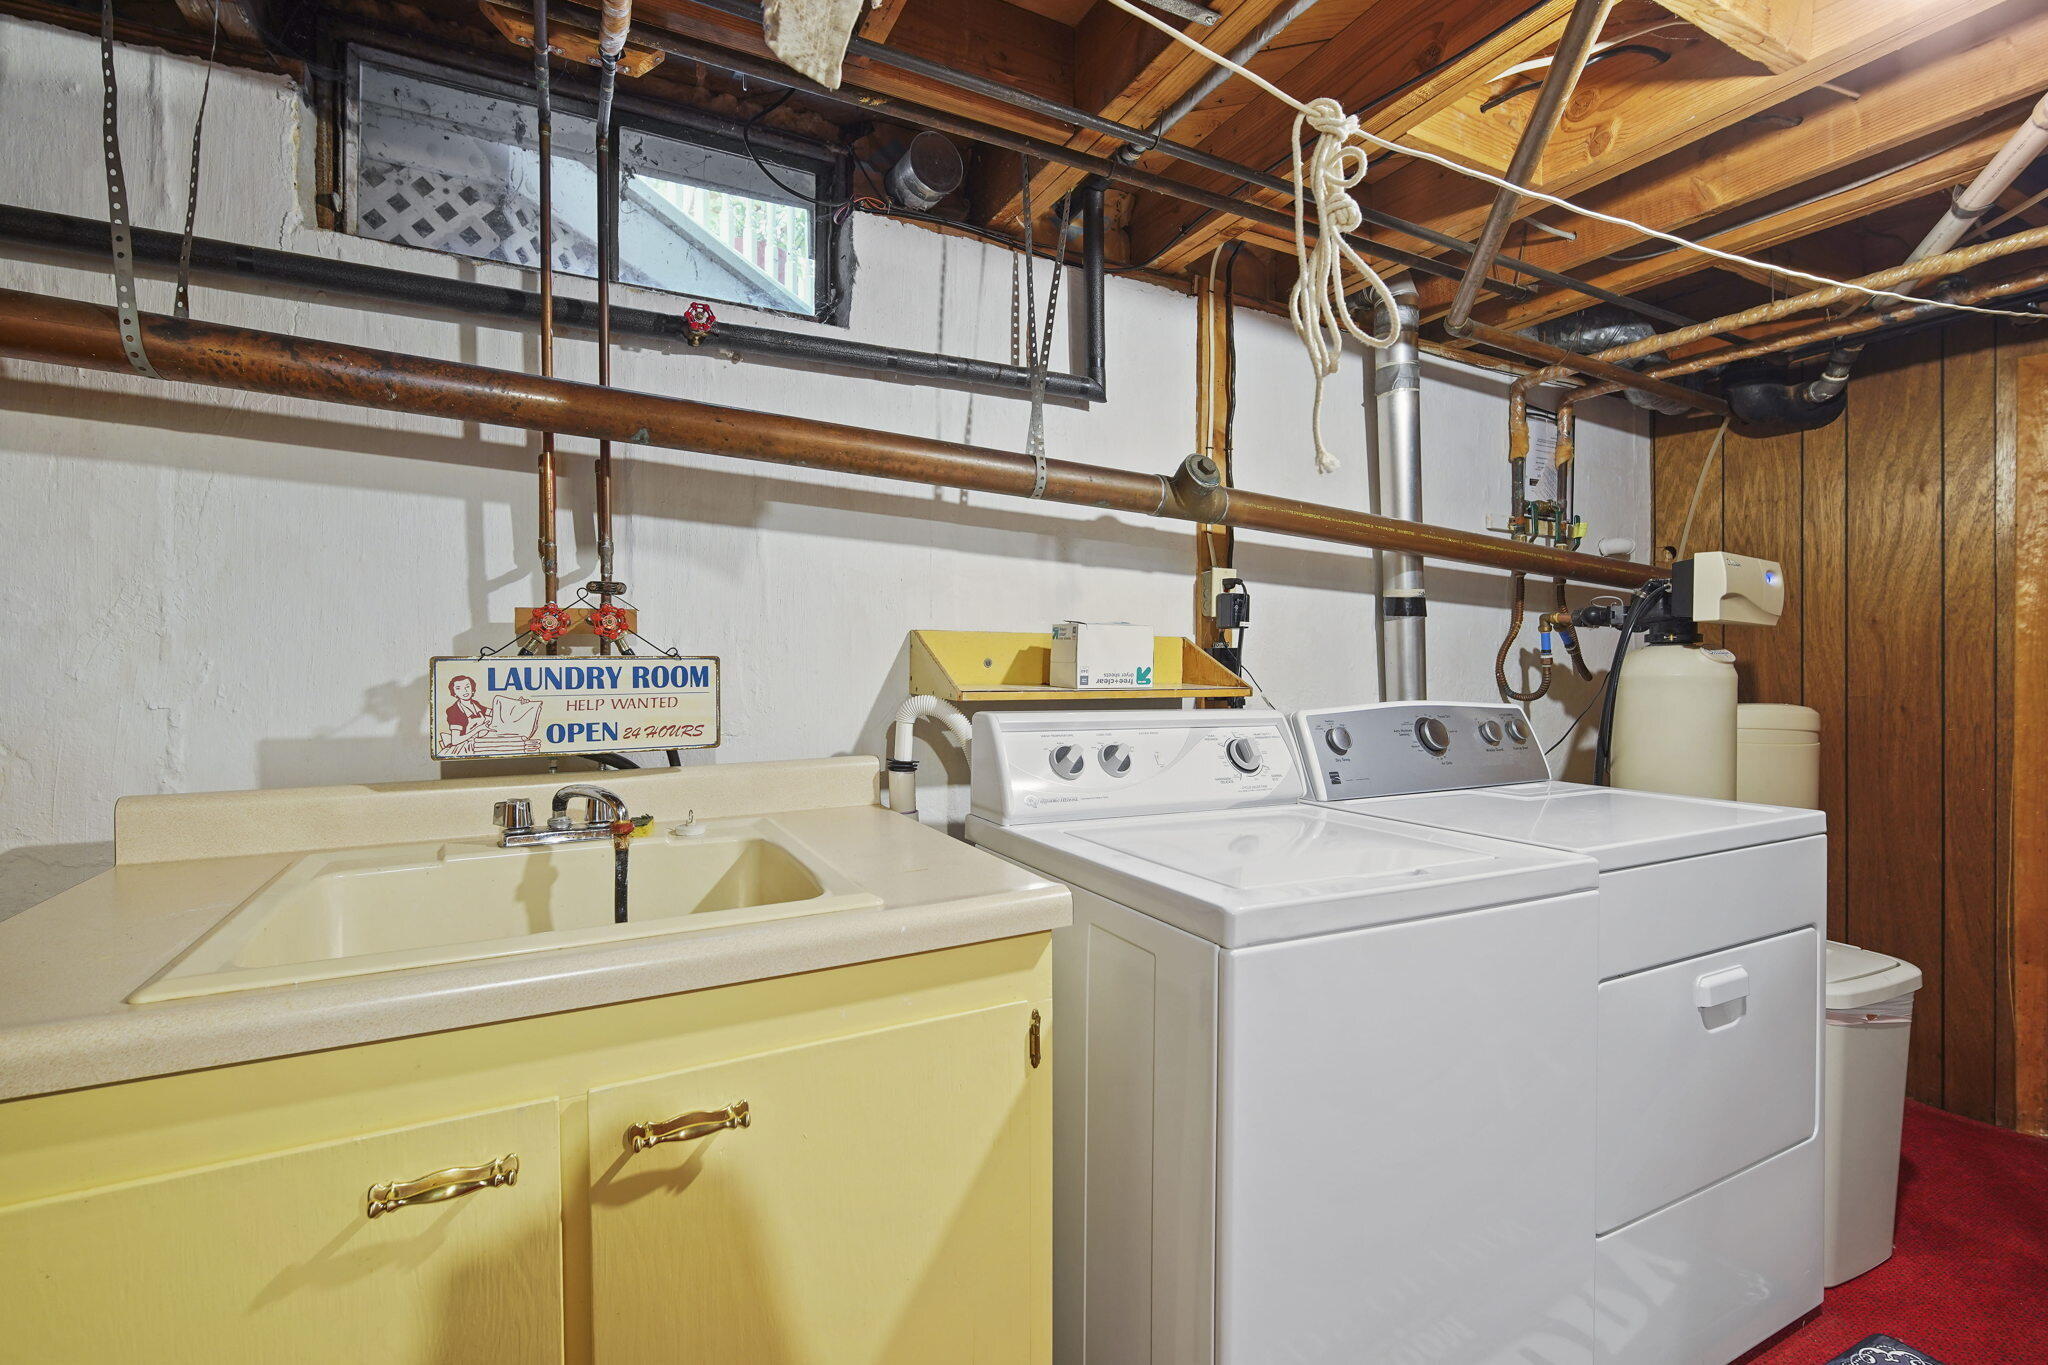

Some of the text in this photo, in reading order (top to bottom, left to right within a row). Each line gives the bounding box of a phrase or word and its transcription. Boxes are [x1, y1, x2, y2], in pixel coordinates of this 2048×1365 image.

[487, 665, 709, 692] LAUNDRY ROOM
[566, 696, 678, 711] HELP WANTED
[546, 722, 704, 744] OPEN 24 HOURS
